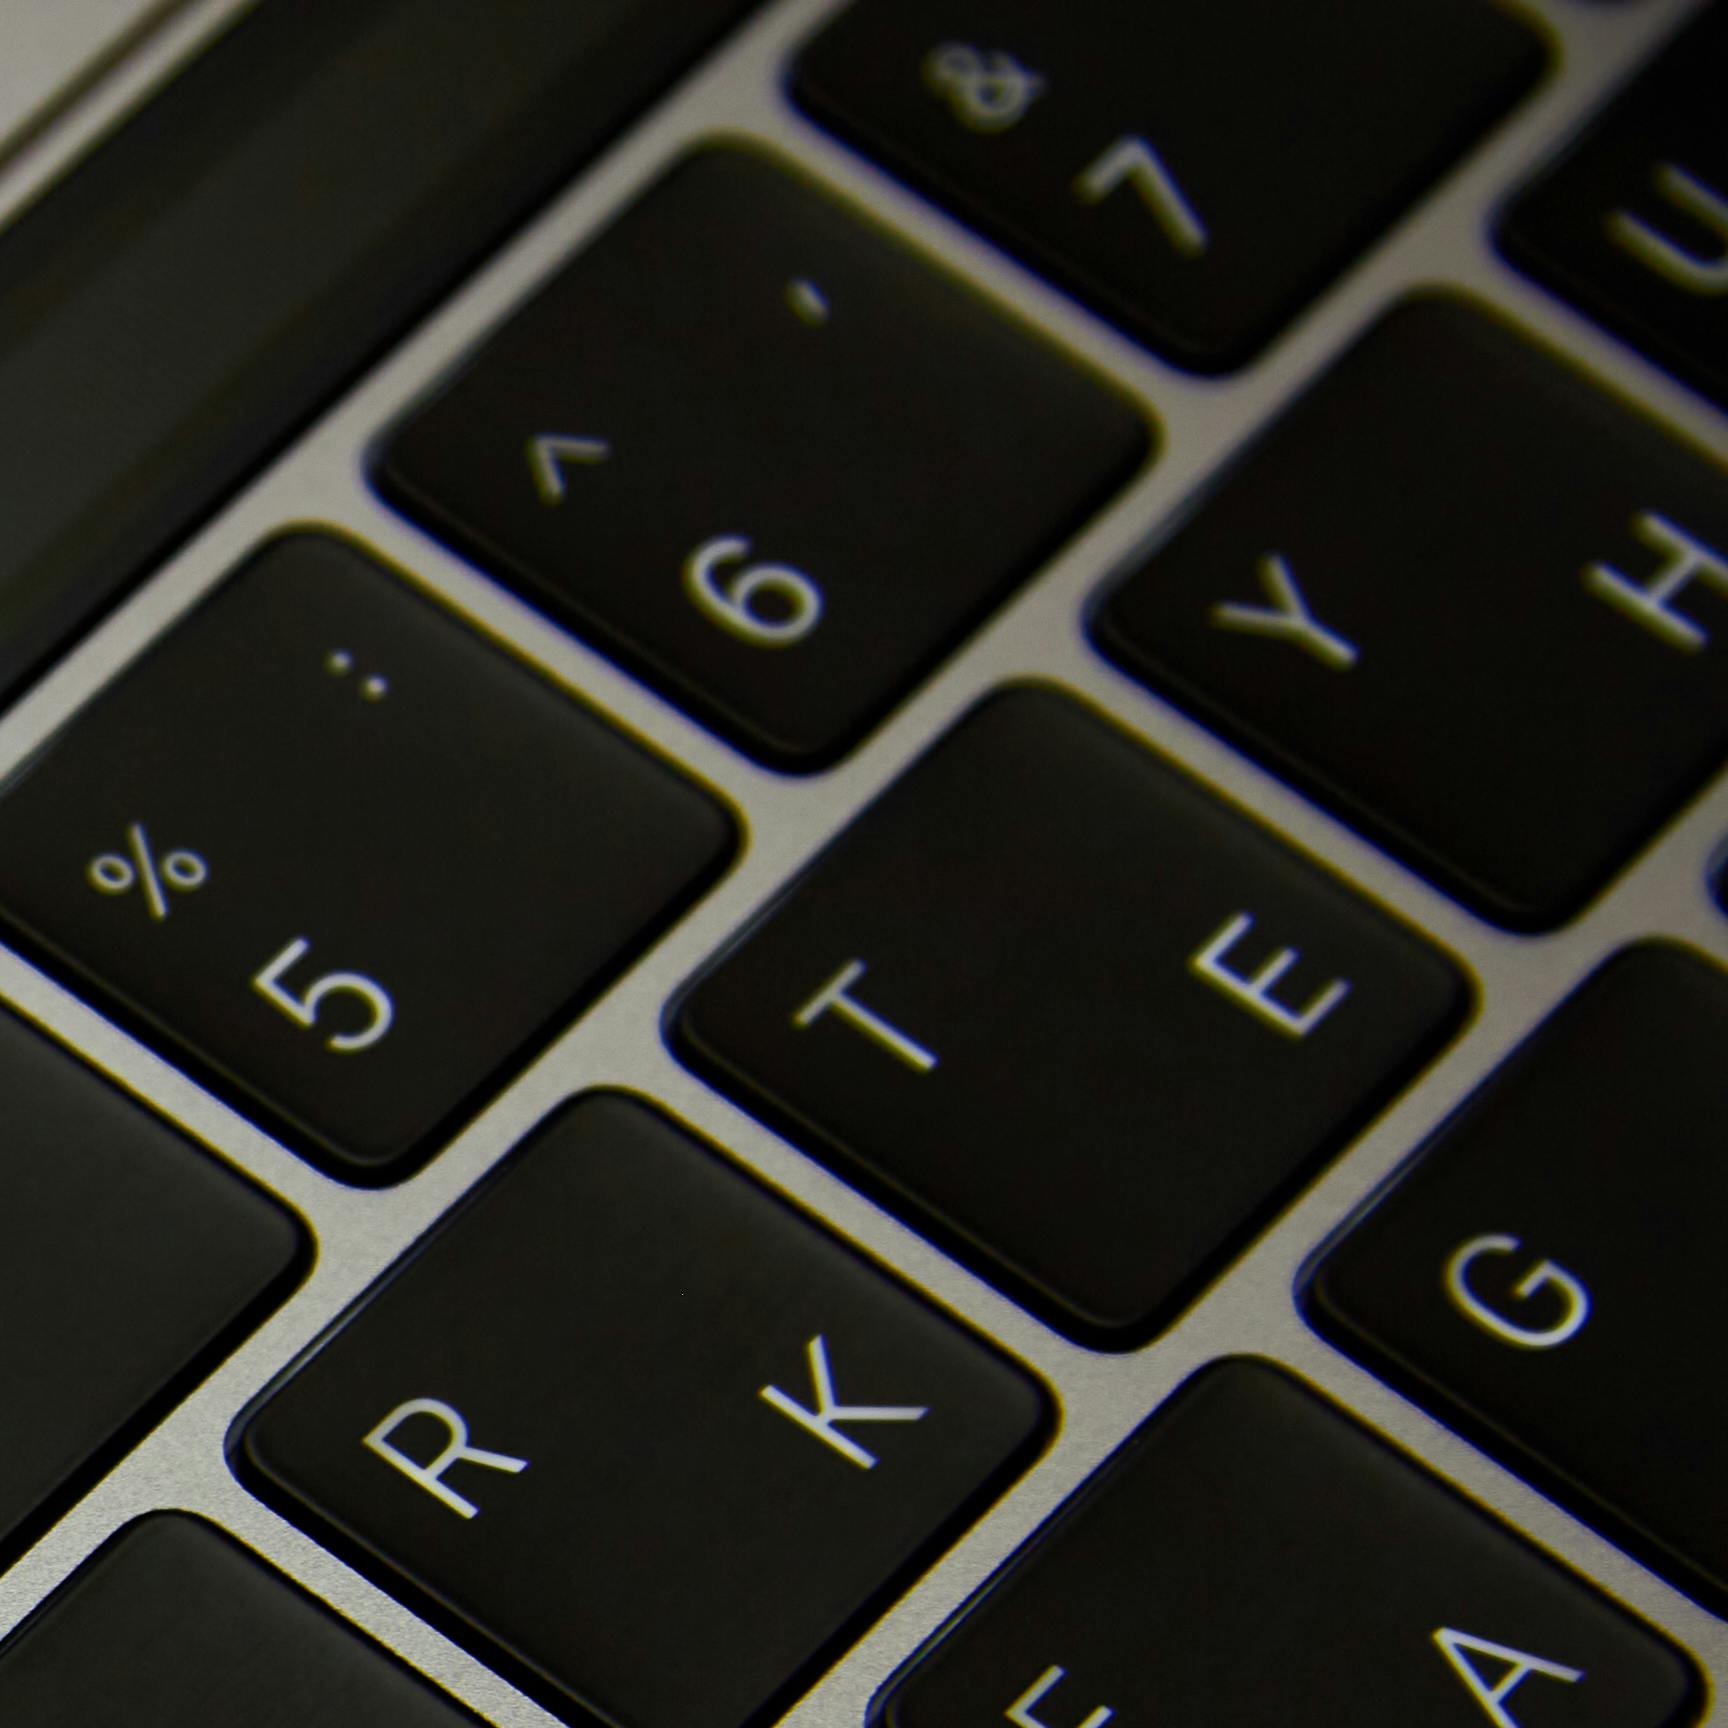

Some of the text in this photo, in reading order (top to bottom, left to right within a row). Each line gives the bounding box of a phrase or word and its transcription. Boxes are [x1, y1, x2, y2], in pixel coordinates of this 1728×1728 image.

[931, 45, 1042, 127] &
[1083, 136, 1208, 247] 7
[686, 534, 825, 643] 6
[1217, 556, 1360, 665] Y
[89, 824, 209, 919] %
[253, 937, 395, 1051] 5
[795, 960, 939, 1070] T
[1446, 1234, 1593, 1348] G
[363, 1397, 530, 1519] R
